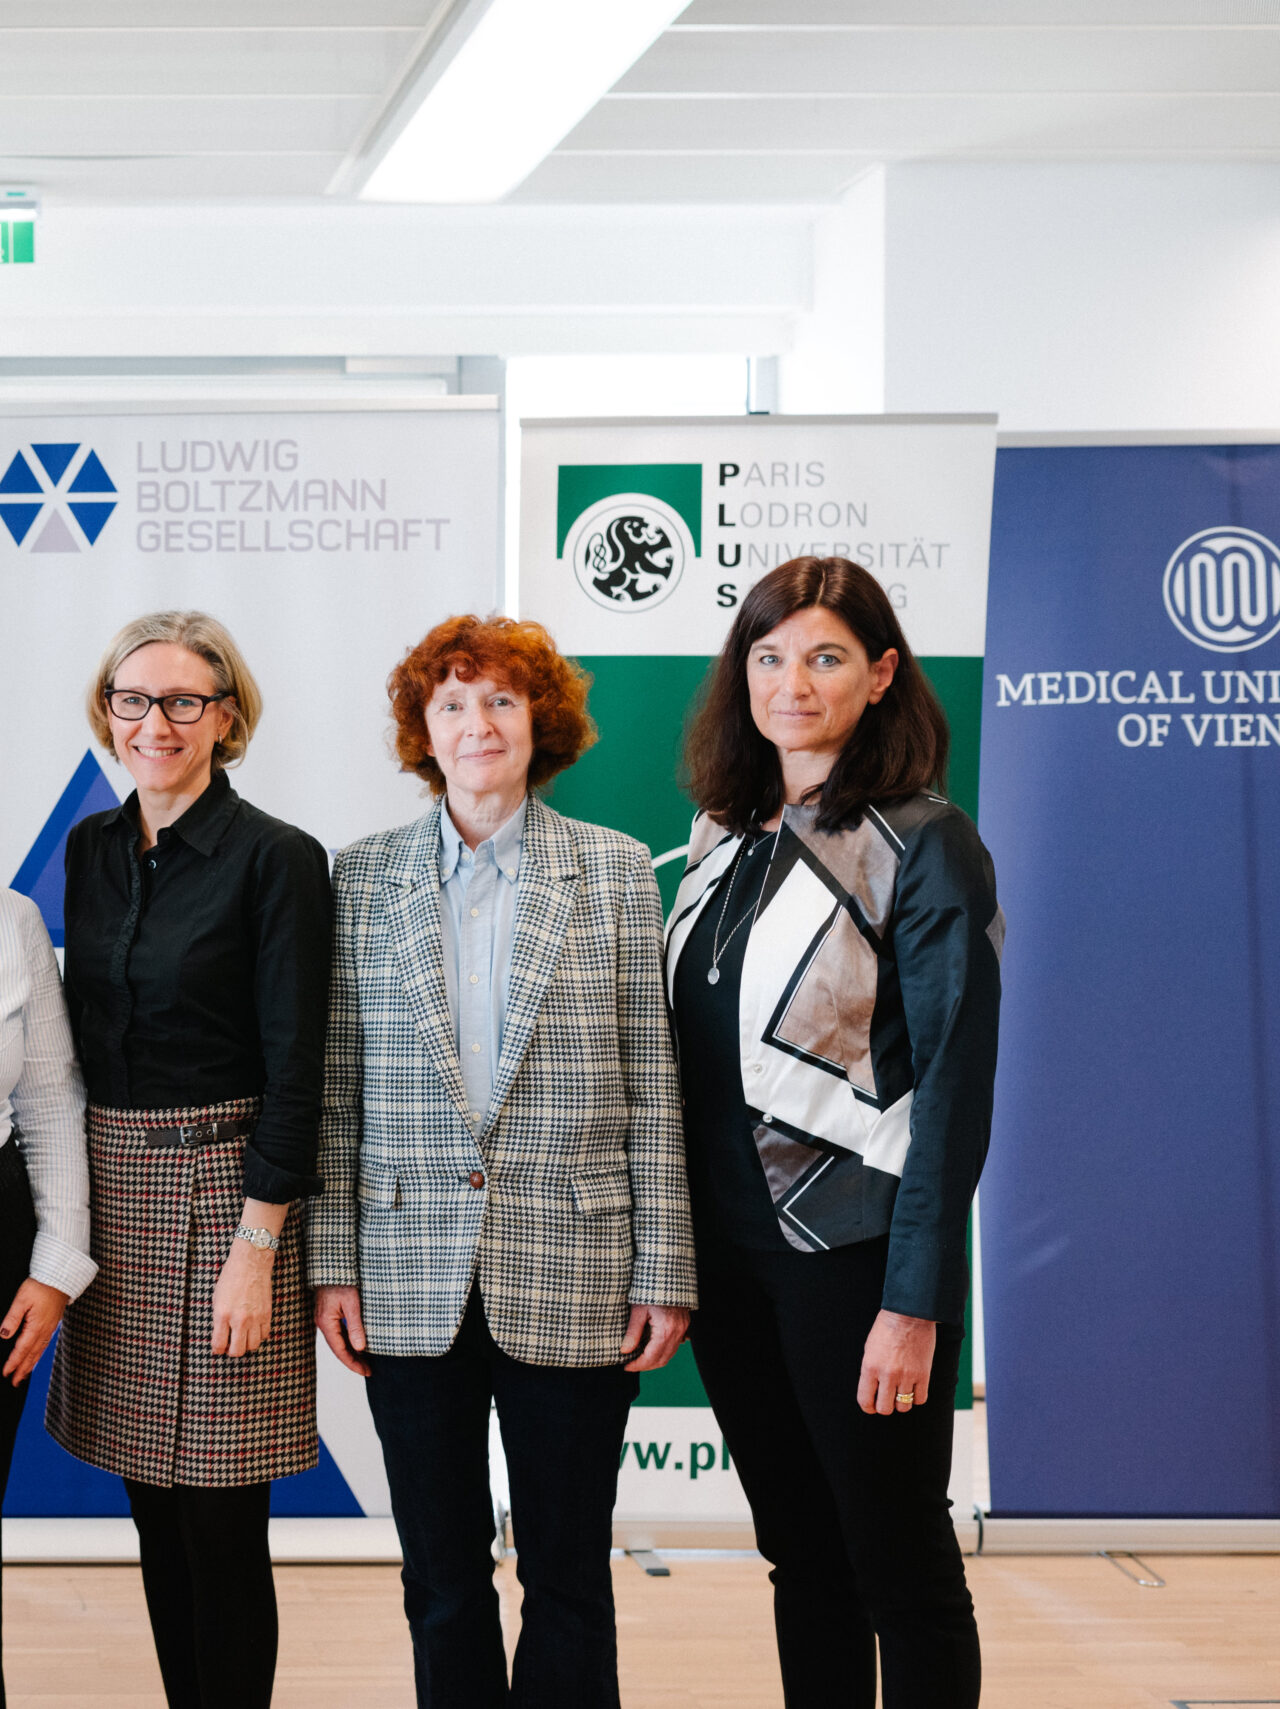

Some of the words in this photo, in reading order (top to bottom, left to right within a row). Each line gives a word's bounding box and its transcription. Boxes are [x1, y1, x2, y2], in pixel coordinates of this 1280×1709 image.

[136, 439, 299, 474] LUDWIG
[718, 461, 826, 488] PARIS
[136, 478, 387, 513] BOLTZMANN
[718, 502, 868, 528] LODRON
[136, 518, 451, 554] GESELLSCHAFT
[996, 670, 1195, 707] MEDICAL
[1117, 713, 1172, 748] OF
